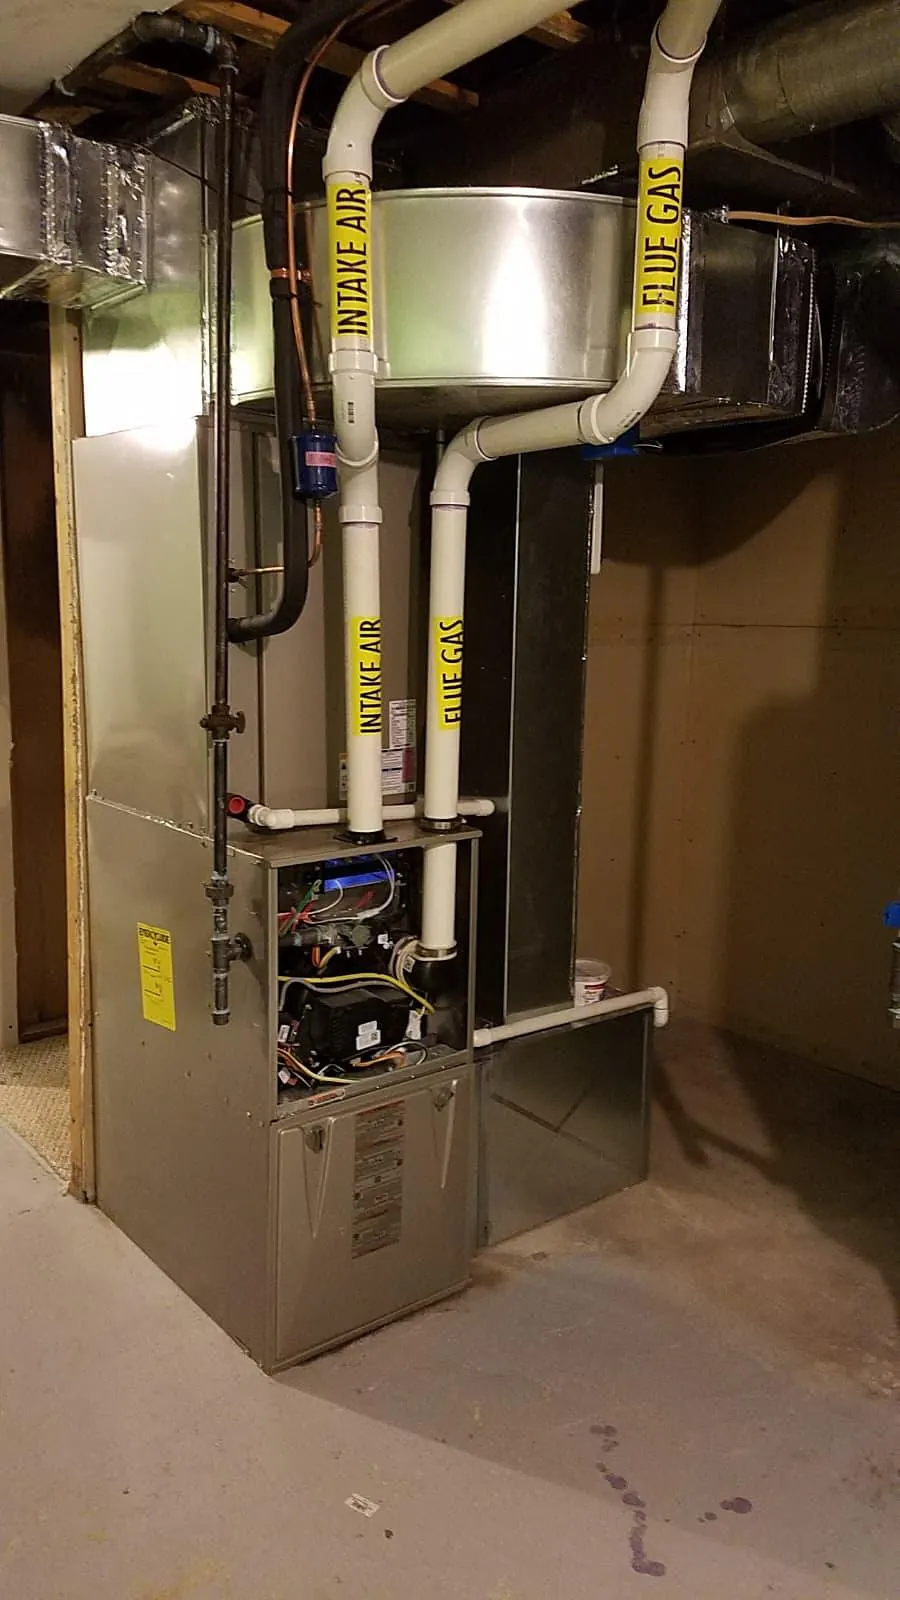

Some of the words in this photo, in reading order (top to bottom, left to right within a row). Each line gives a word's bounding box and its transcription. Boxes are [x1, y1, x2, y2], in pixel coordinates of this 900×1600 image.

[336, 188, 367, 234] AIR
[646, 166, 681, 225] GAS
[336, 241, 368, 335] INTAKE
[642, 237, 679, 306] FLUE
[360, 619, 382, 653] AIR
[439, 620, 463, 664] GAS
[360, 661, 382, 734] INTAKE
